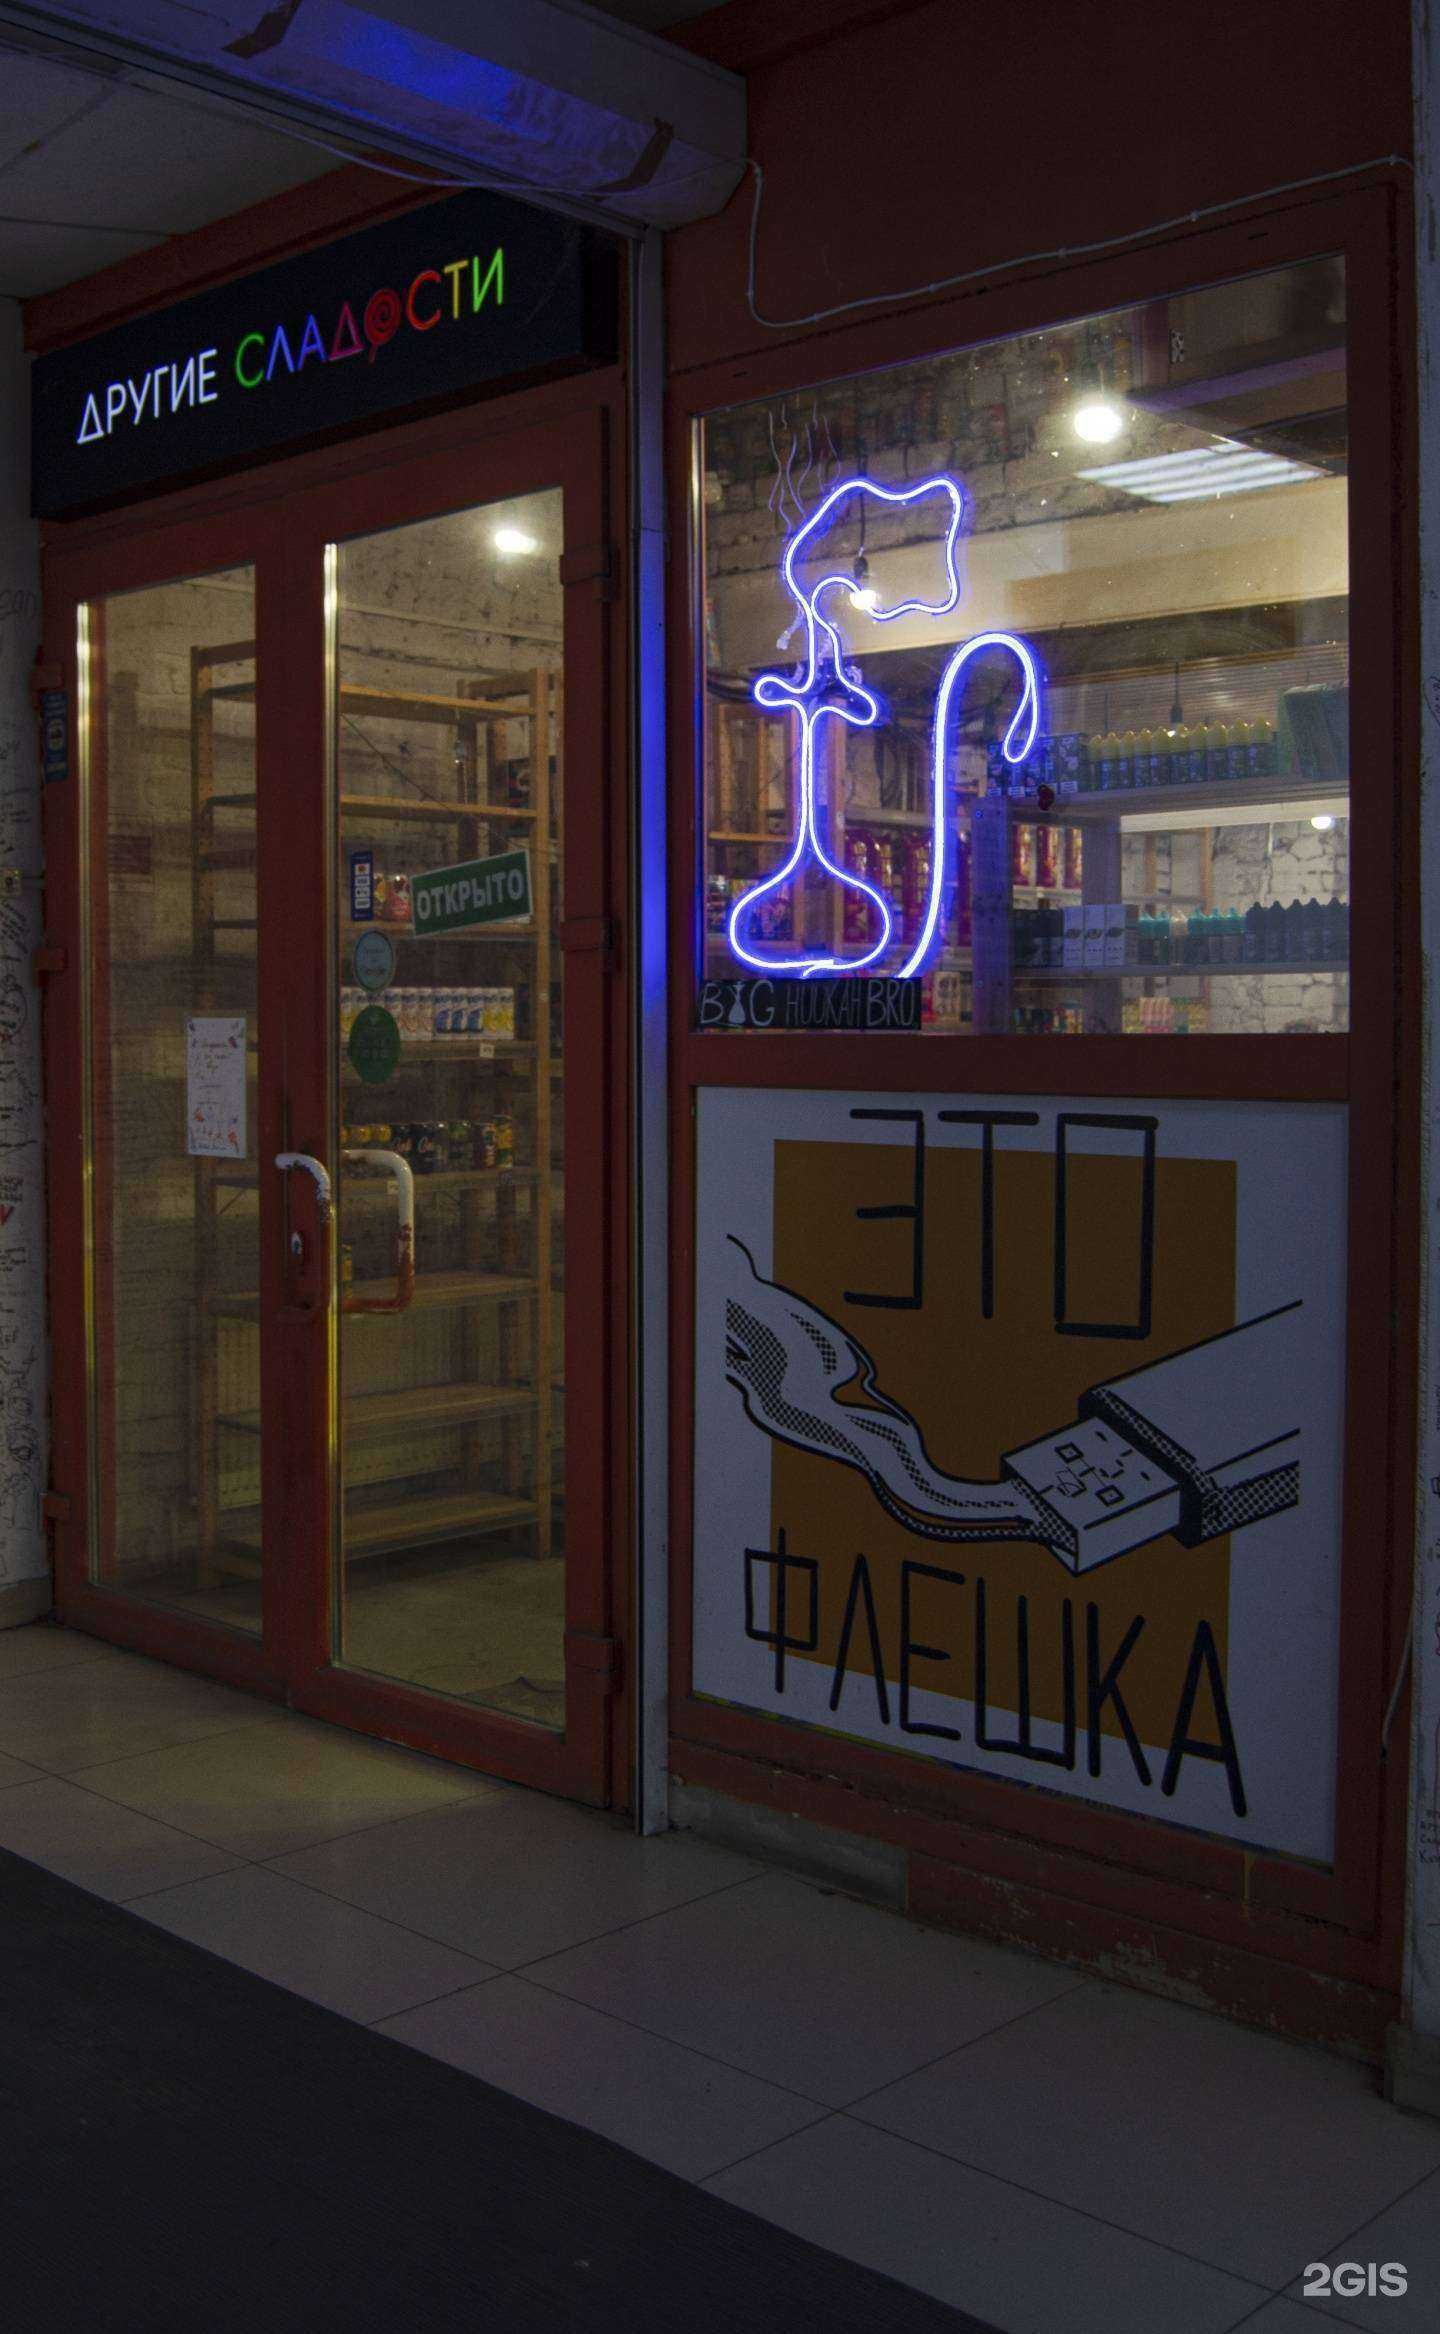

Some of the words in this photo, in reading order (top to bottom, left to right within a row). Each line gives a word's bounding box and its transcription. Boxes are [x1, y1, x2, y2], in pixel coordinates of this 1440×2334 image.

[76, 346, 220, 446] ДРУГИЕ
[233, 246, 506, 390] СЛАДОСТИ
[416, 868, 525, 920] ОТКРЫТО
[865, 979, 917, 1028] BRO
[843, 1107, 1159, 1339] ЭТО
[744, 1527, 1248, 1818] ФЛЕШКА
